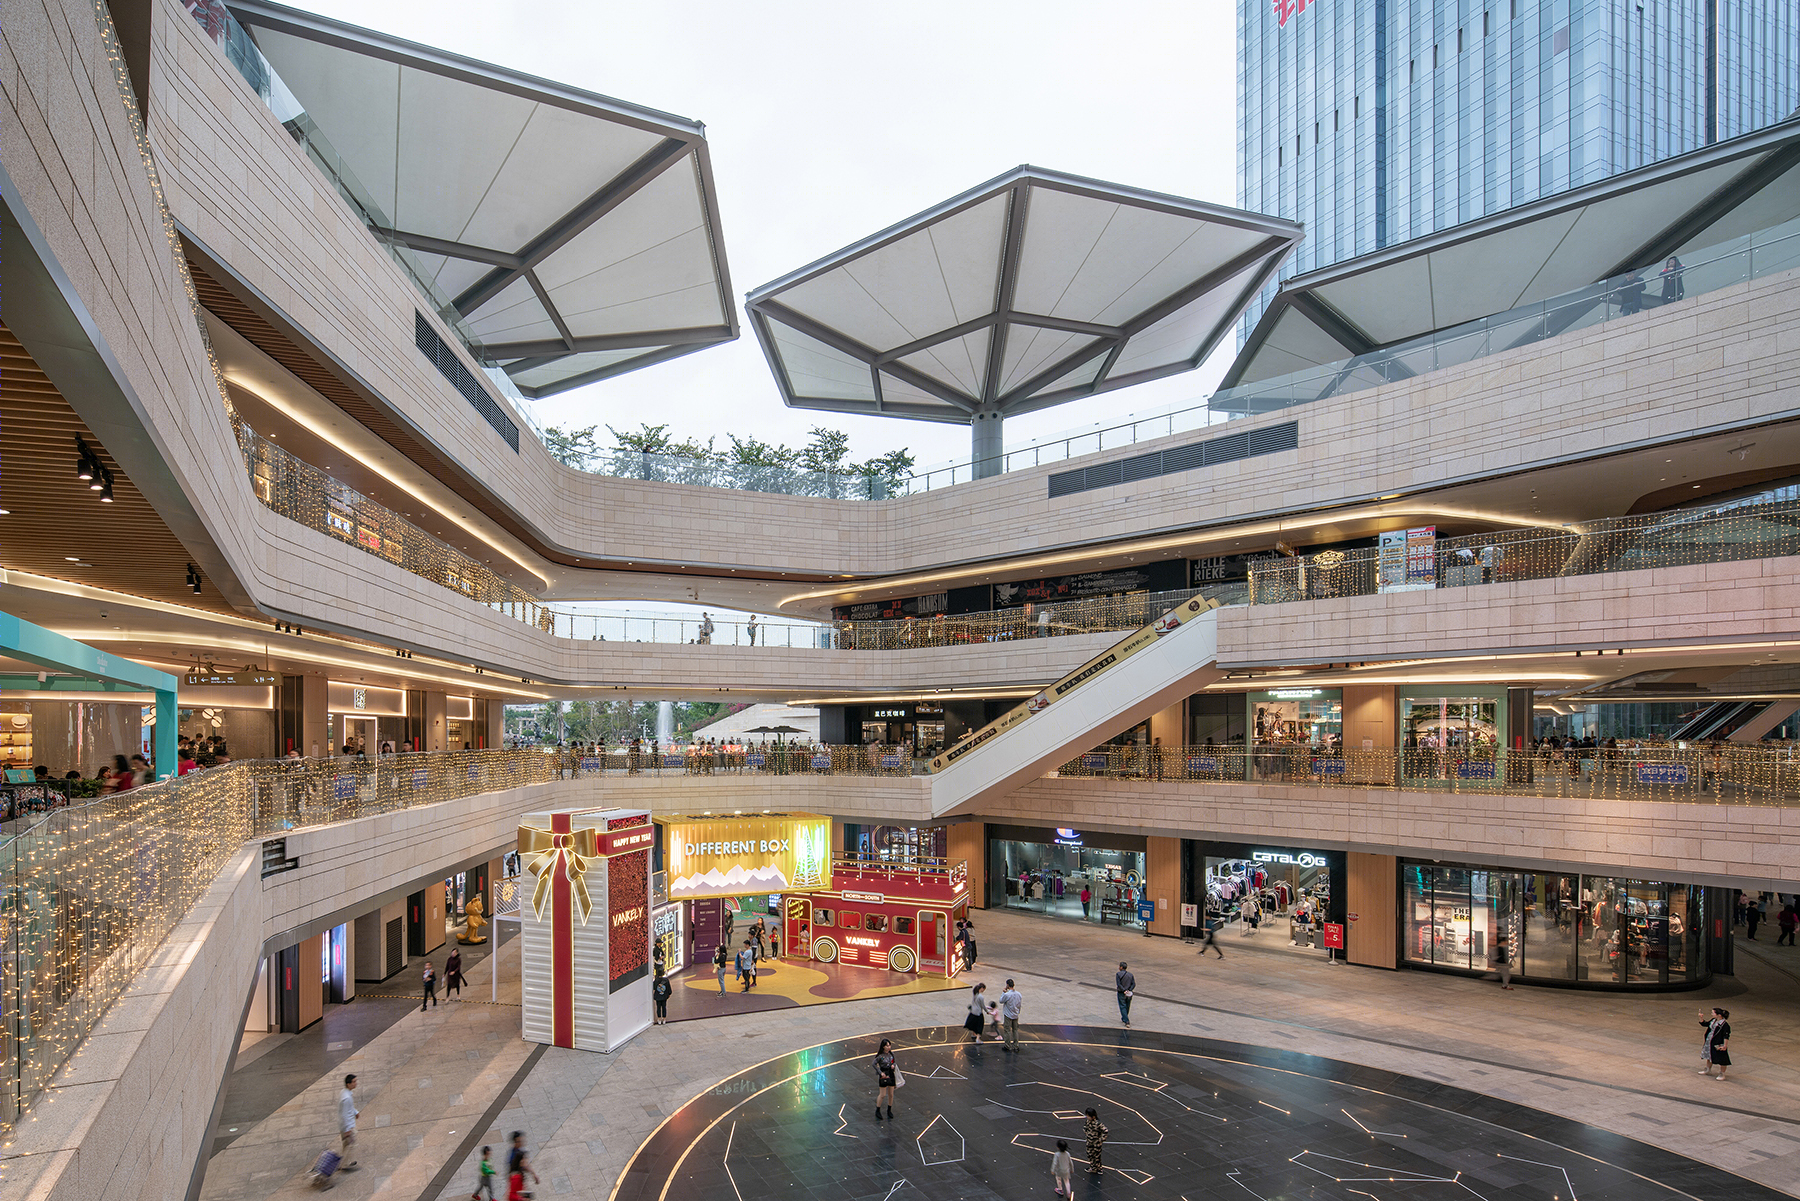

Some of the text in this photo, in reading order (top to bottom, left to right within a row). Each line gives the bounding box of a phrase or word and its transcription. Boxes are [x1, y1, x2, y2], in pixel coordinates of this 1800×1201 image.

[1195, 556, 1226, 569] JELLE
[1195, 567, 1226, 580] RIEKE
[189, 676, 198, 684] L1
[613, 832, 652, 848] HAPPY NEW YEAR
[685, 839, 790, 856] DIFFERENT BOX
[612, 906, 643, 927] VANKELY
[1454, 907, 1470, 915] THE
[845, 936, 880, 947] VANKELY
